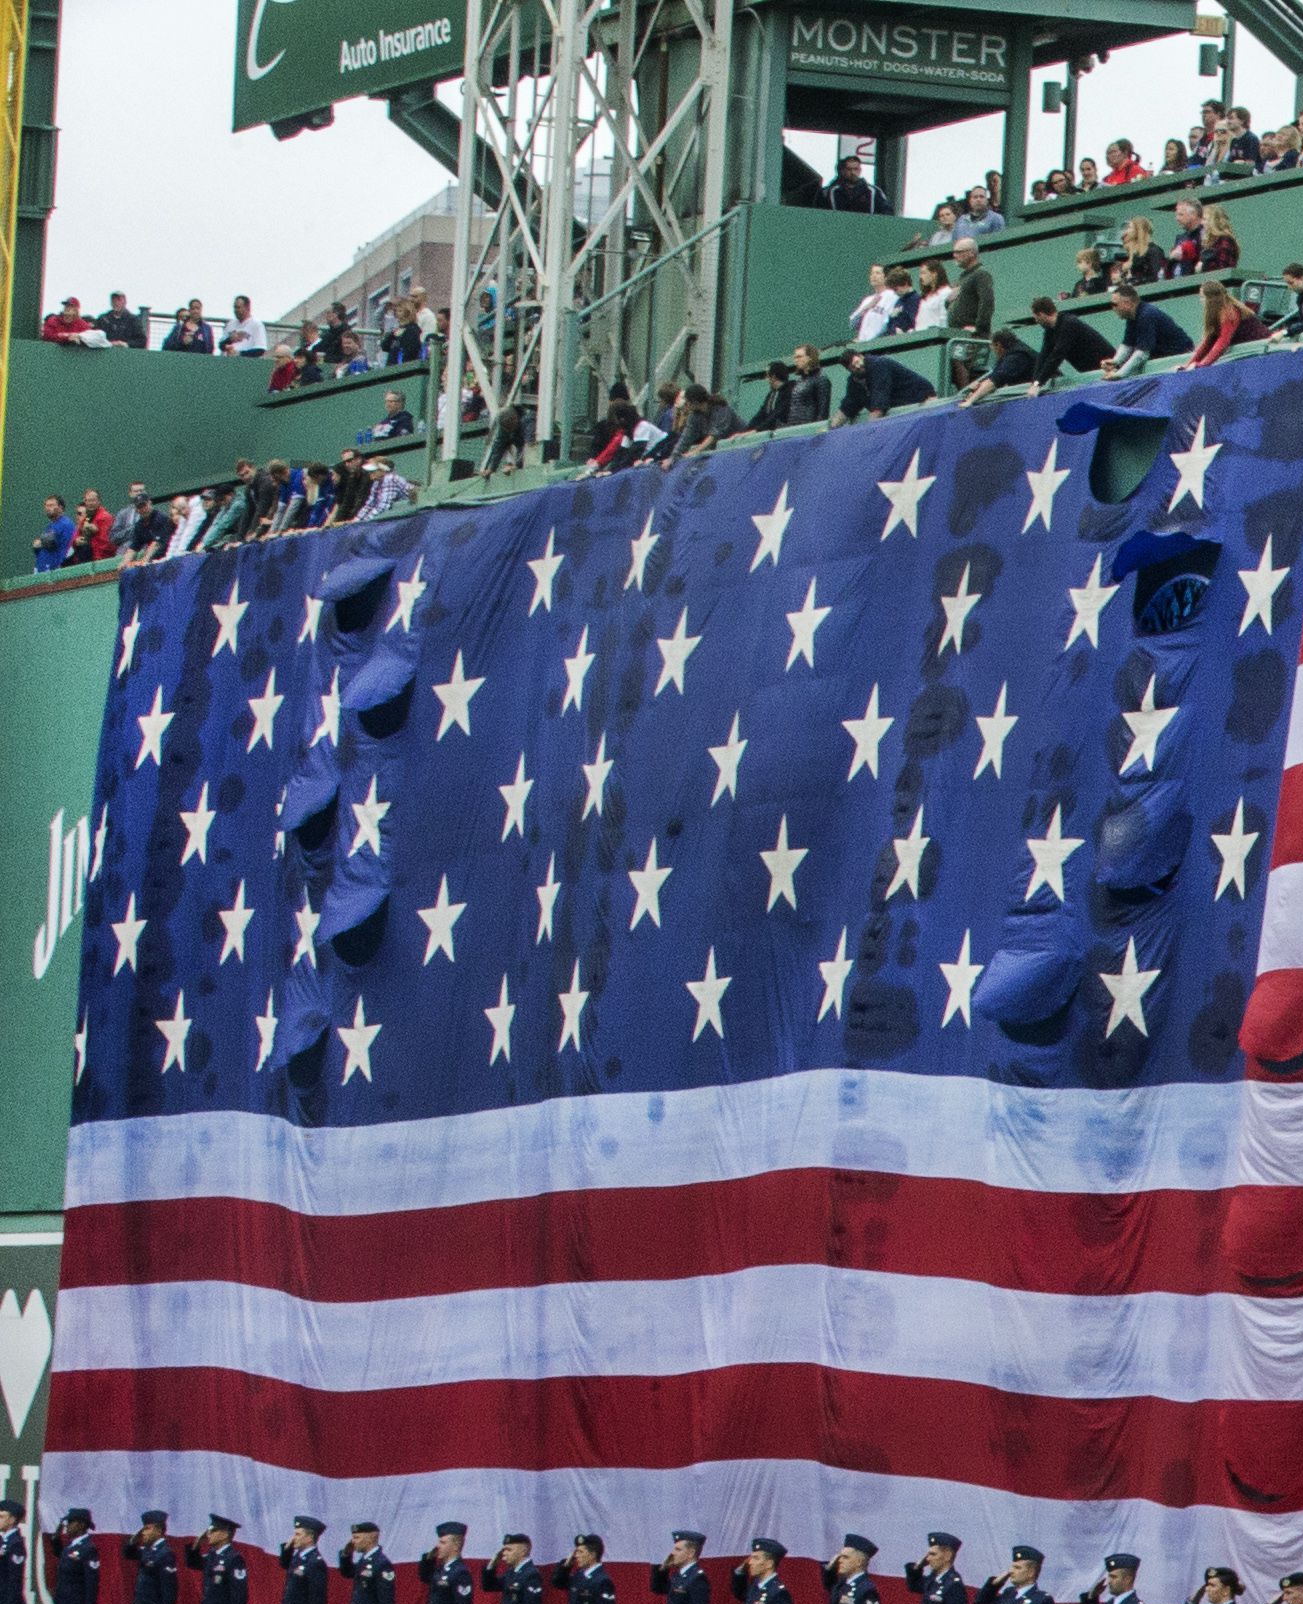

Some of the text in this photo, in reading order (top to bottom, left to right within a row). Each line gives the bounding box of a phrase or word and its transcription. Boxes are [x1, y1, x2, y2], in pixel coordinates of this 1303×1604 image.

[339, 17, 452, 73] Auto Insurance
[792, 16, 1007, 67] MONSTER
